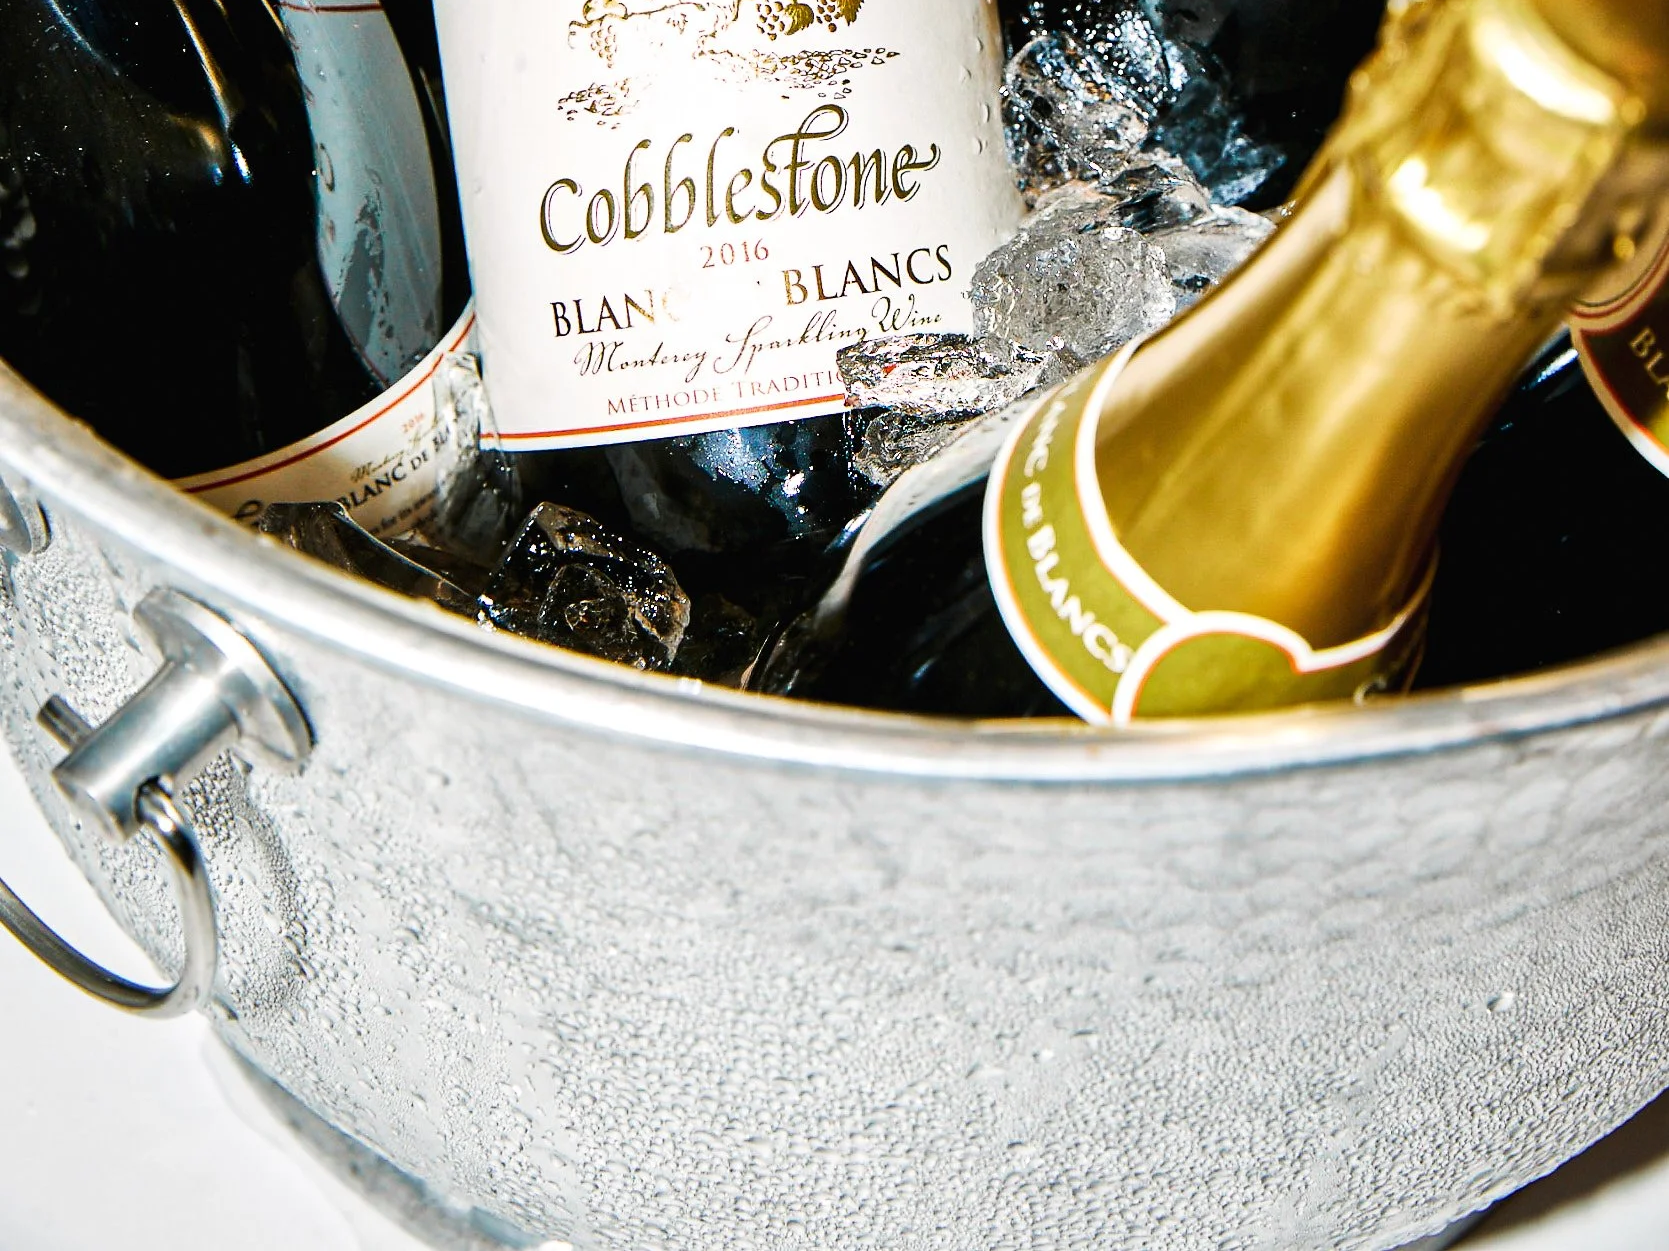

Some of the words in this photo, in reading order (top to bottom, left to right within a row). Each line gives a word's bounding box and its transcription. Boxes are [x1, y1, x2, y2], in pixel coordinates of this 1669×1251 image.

[540, 103, 941, 255] Cobblestone
[700, 238, 770, 270] 2016
[782, 244, 953, 306] BLANCS
[573, 340, 707, 384] Monterey
[713, 308, 871, 376] Sparkling
[871, 293, 942, 333] Wine
[607, 387, 721, 416] MÉTHODE
[1027, 523, 1135, 674] BLANCS
